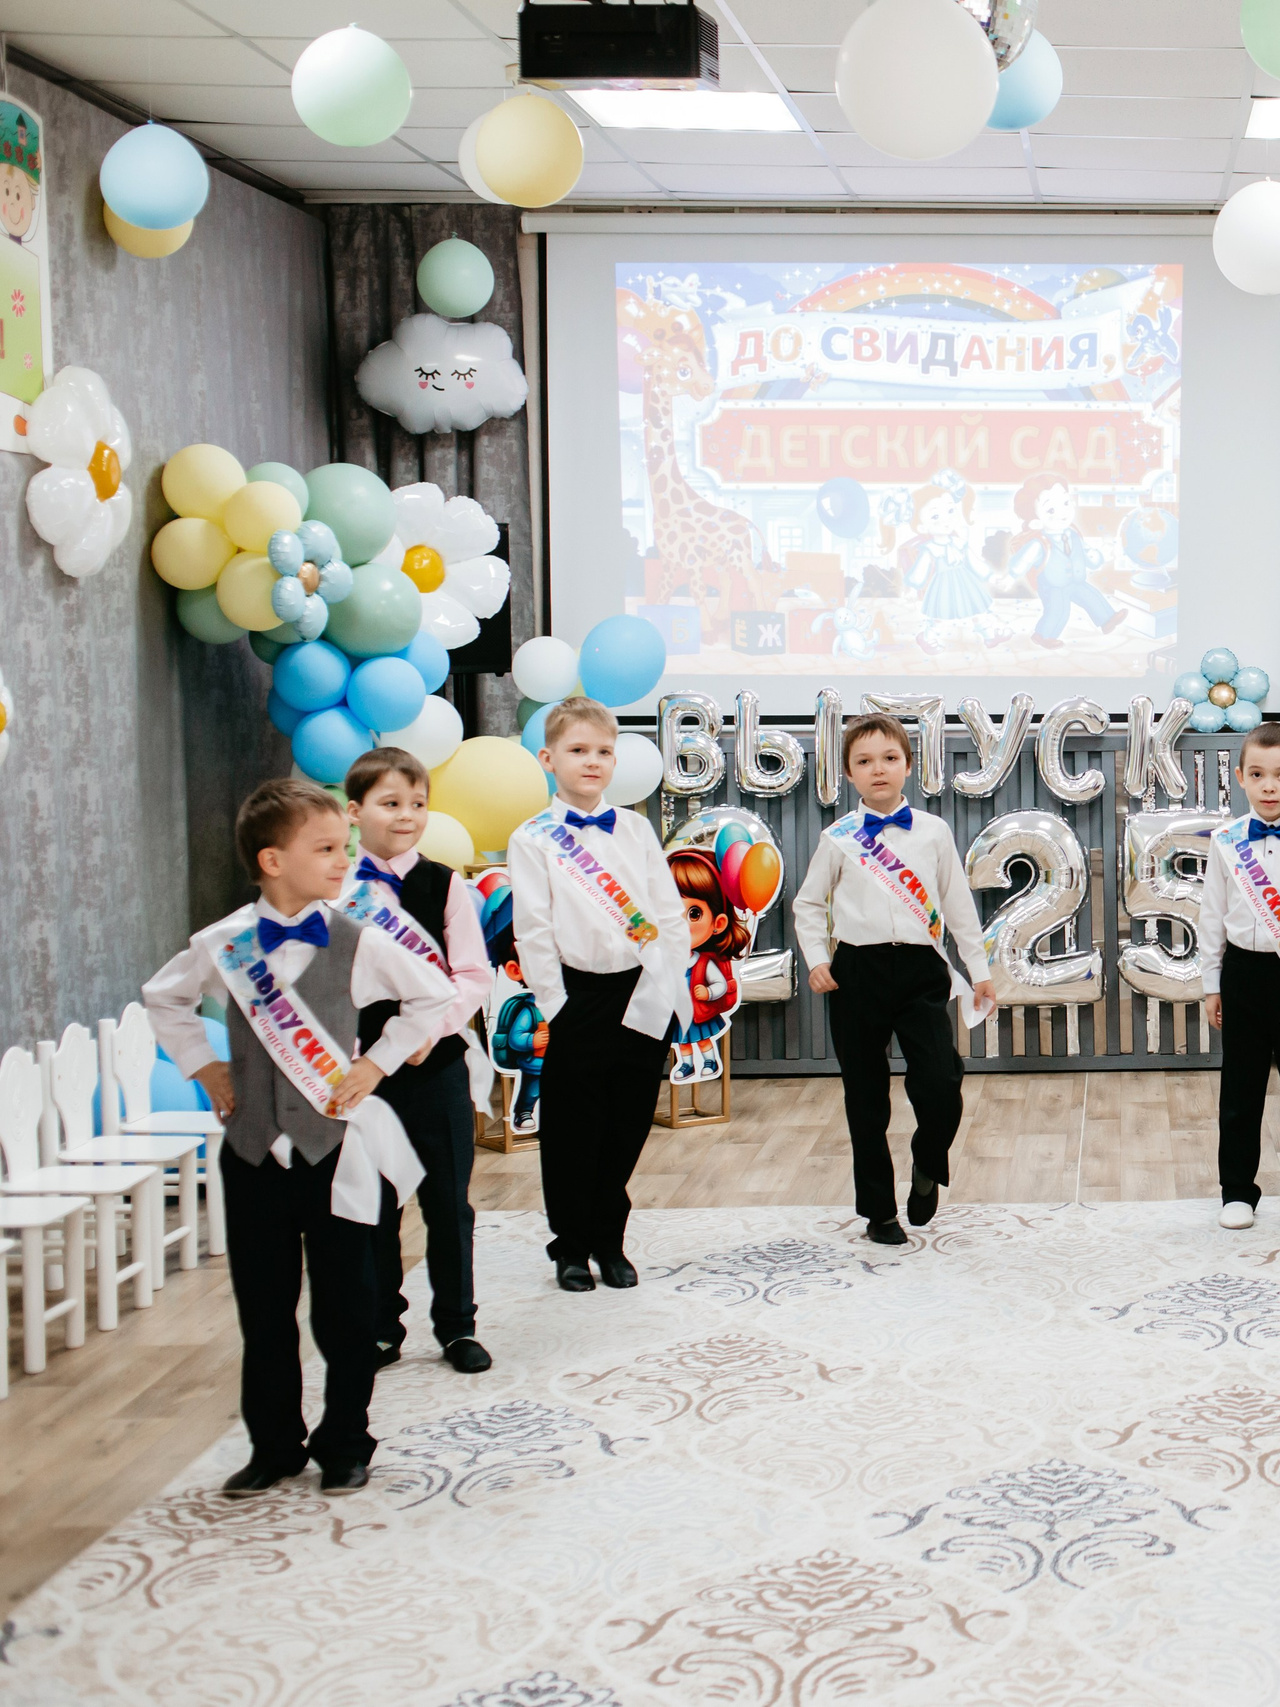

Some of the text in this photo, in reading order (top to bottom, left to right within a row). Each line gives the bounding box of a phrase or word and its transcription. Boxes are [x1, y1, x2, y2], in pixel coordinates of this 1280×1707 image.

[730, 325, 1118, 377] ДО СВИДАНИЯ,
[734, 412, 1121, 480] ДЕТСКИЙ САД
[671, 618, 691, 644] Б
[757, 623, 783, 648] Ж
[657, 686, 1195, 807] ВЫПУСК
[550, 824, 646, 929] ВЫПУСКНИК
[566, 864, 626, 928] детского сада
[662, 804, 1232, 1007] 225
[868, 862, 928, 925] детского сада
[1239, 875, 1269, 918] детского
[246, 959, 350, 1089] ВЫПУСКНИ
[258, 1016, 330, 1106] детского сада
